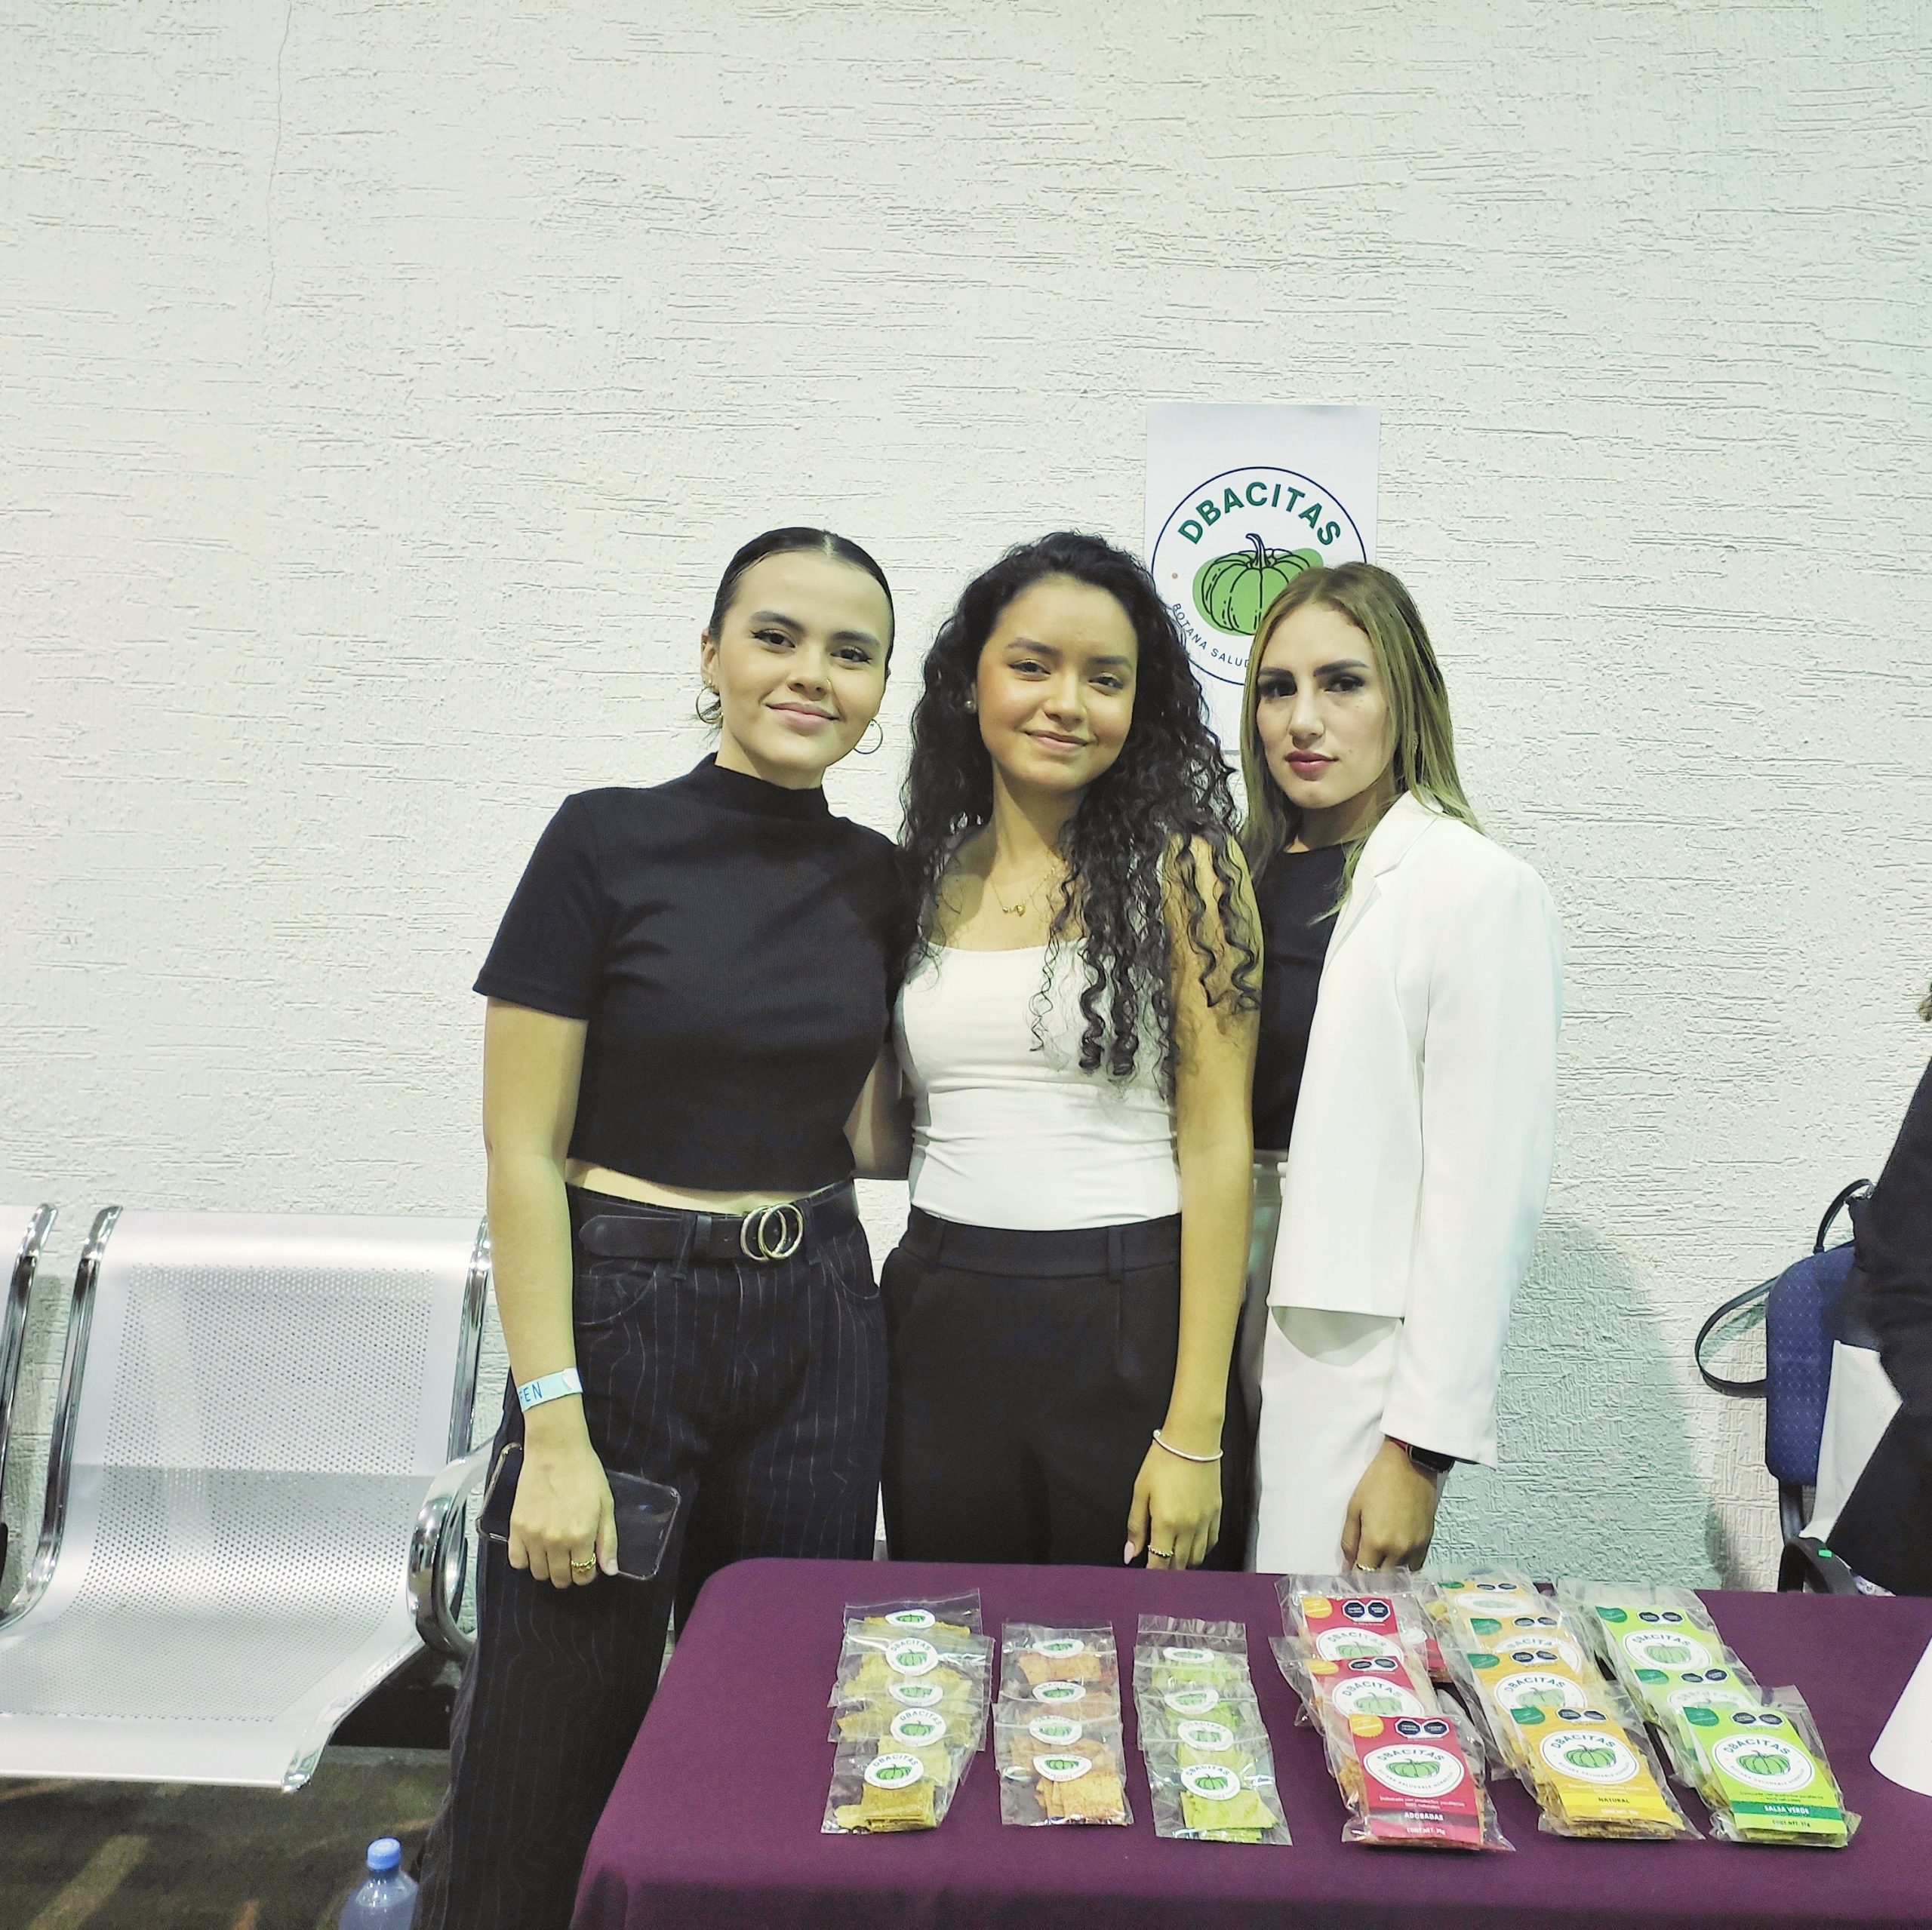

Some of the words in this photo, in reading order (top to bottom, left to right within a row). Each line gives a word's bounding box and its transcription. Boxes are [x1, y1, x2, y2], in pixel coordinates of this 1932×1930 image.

[1177, 481, 1341, 546] DBACITAS
[1172, 603, 1208, 650] BOTANA
[891, 1640, 931, 1652] DBACITAS
[1342, 1680, 1403, 1698] DBACITAS
[1503, 1676, 1566, 1692] DBACITAS
[900, 1710, 942, 1726] DBACITAS
[1551, 1735, 1616, 1749] DBACITAS
[1723, 1738, 1791, 1754] DBACITAS
[872, 1754, 918, 1767] DBACITAS
[1377, 1749, 1445, 1761] DBACITAS
[1404, 1812, 1444, 1821] ADOBADAS
[1764, 1805, 1786, 1813] SALSA
